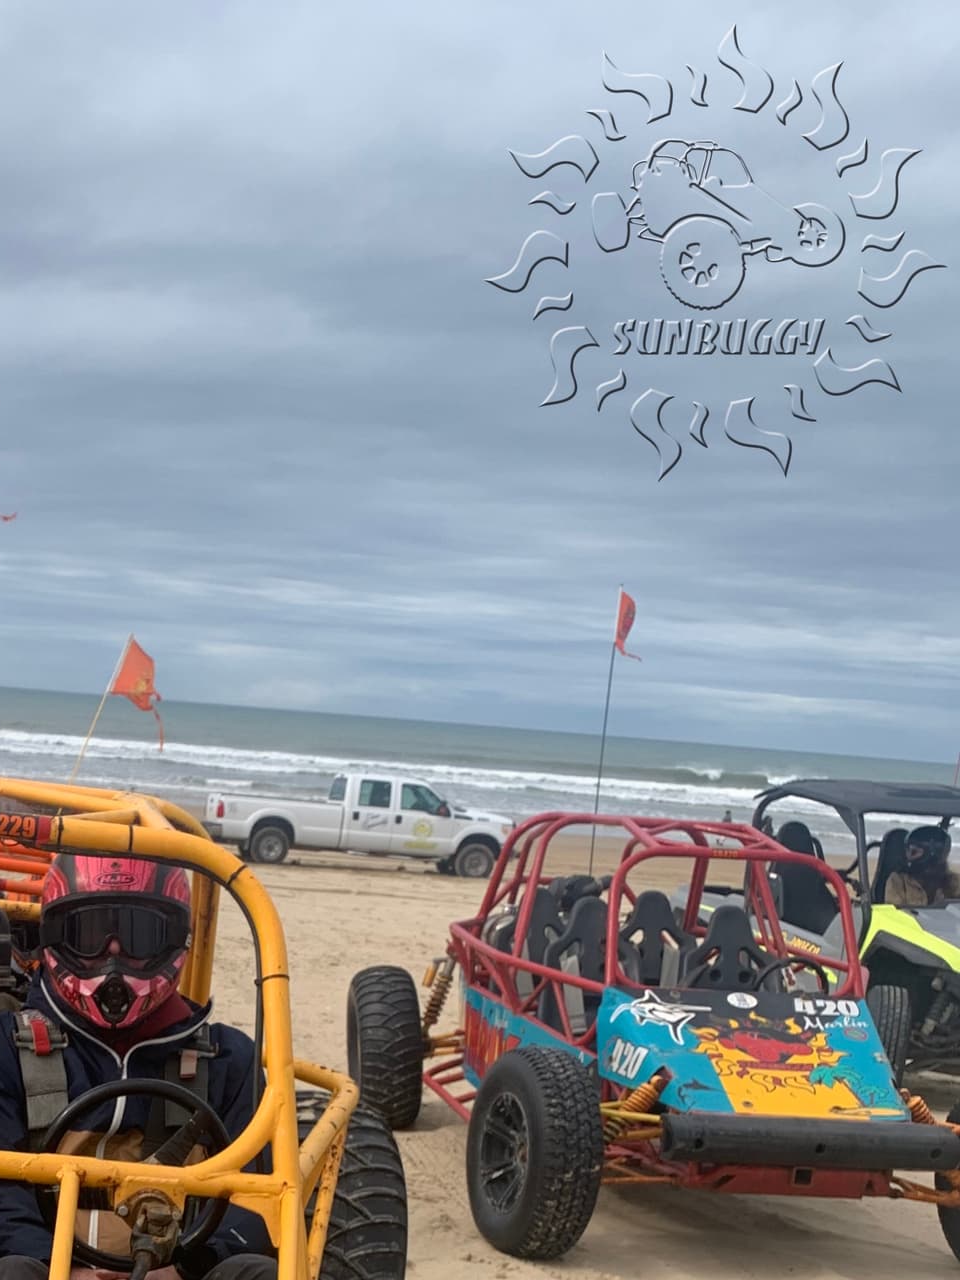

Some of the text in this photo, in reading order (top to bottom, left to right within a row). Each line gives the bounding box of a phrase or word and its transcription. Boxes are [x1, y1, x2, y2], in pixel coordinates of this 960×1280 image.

[793, 997, 860, 1017] 420
[803, 1016, 869, 1032] Marlin
[609, 1038, 650, 1080] 420
